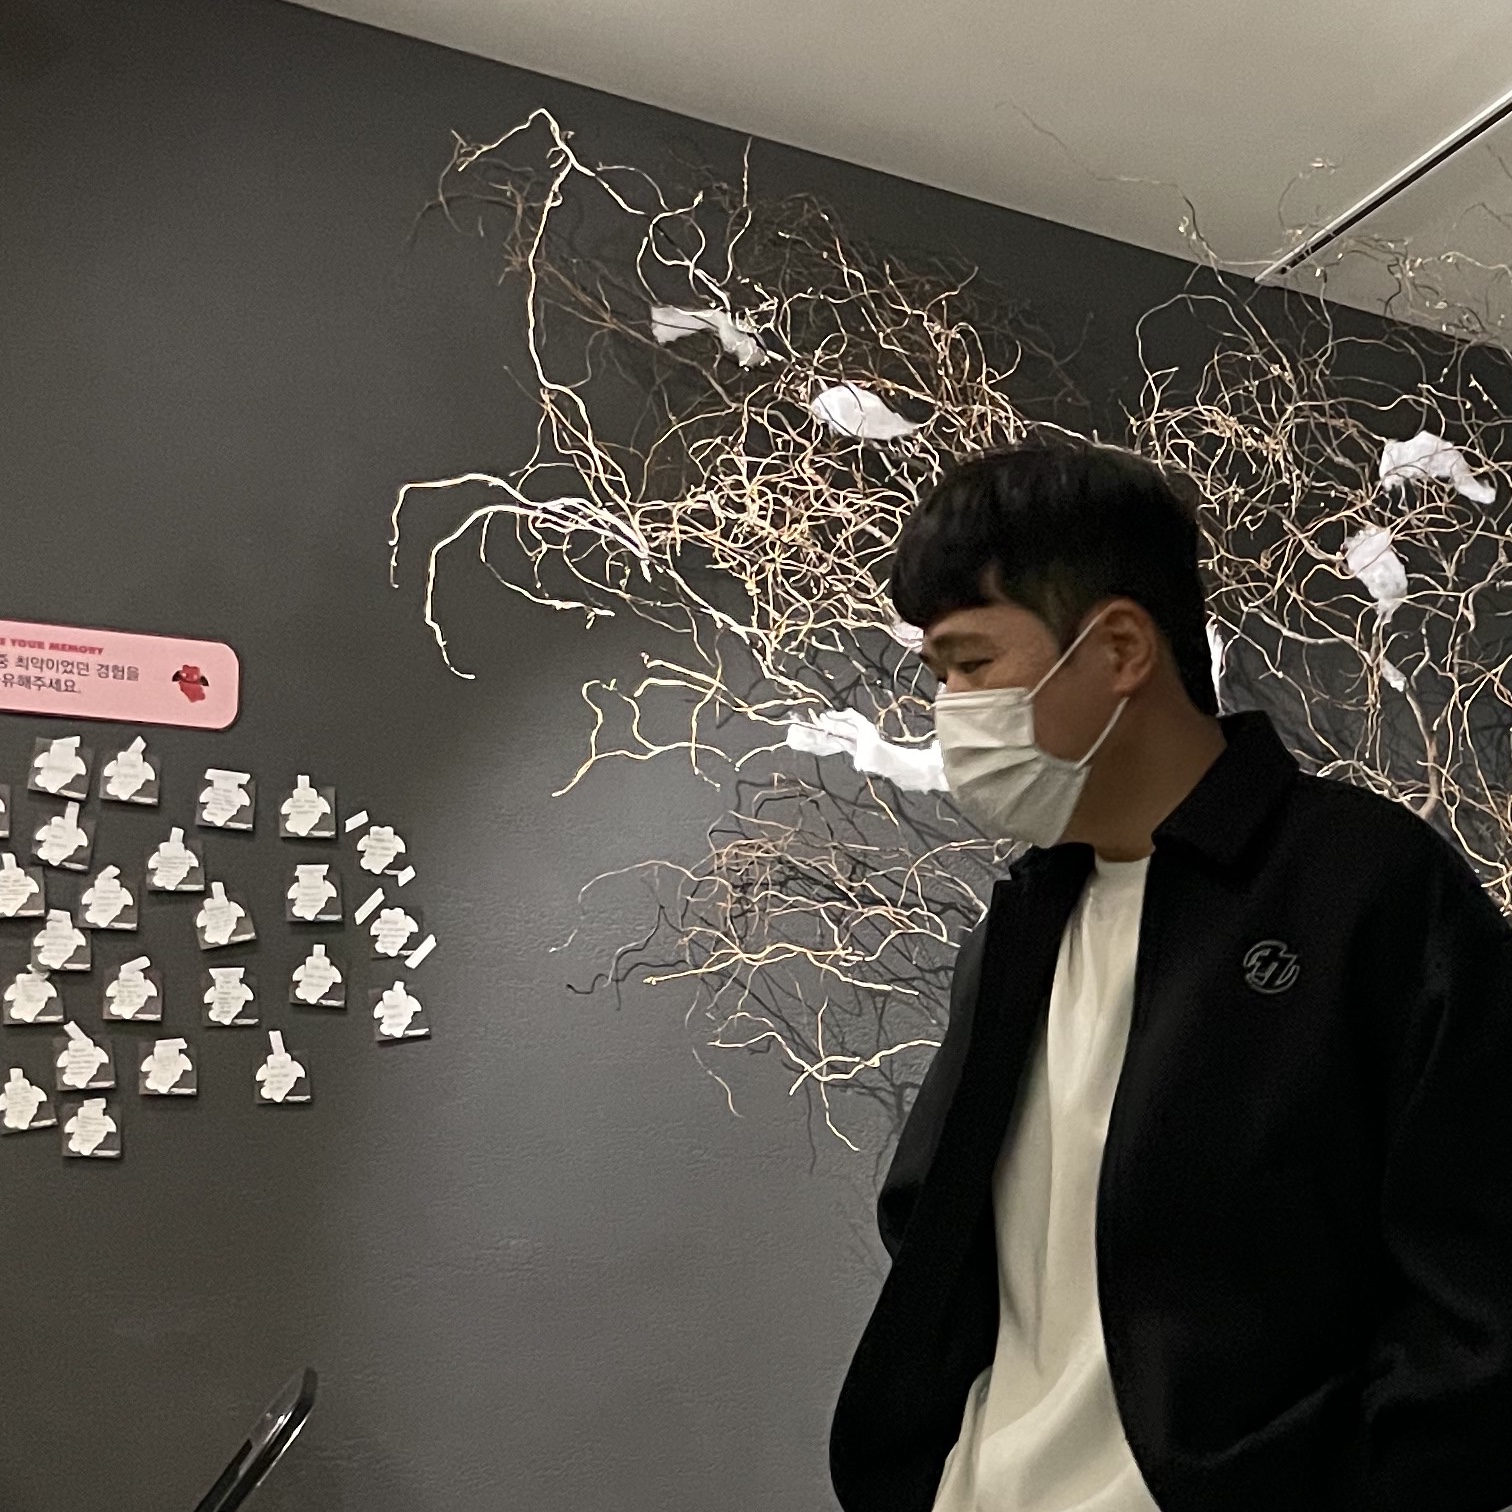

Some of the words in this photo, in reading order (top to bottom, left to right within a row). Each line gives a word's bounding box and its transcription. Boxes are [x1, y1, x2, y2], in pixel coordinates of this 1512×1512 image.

[10, 639, 45, 649] YOUR
[48, 642, 104, 655] MEMORY
[15, 655, 90, 677] 최악이었던
[96, 663, 140, 681] 경험을
[0, 672, 82, 693] 유해주세요.
